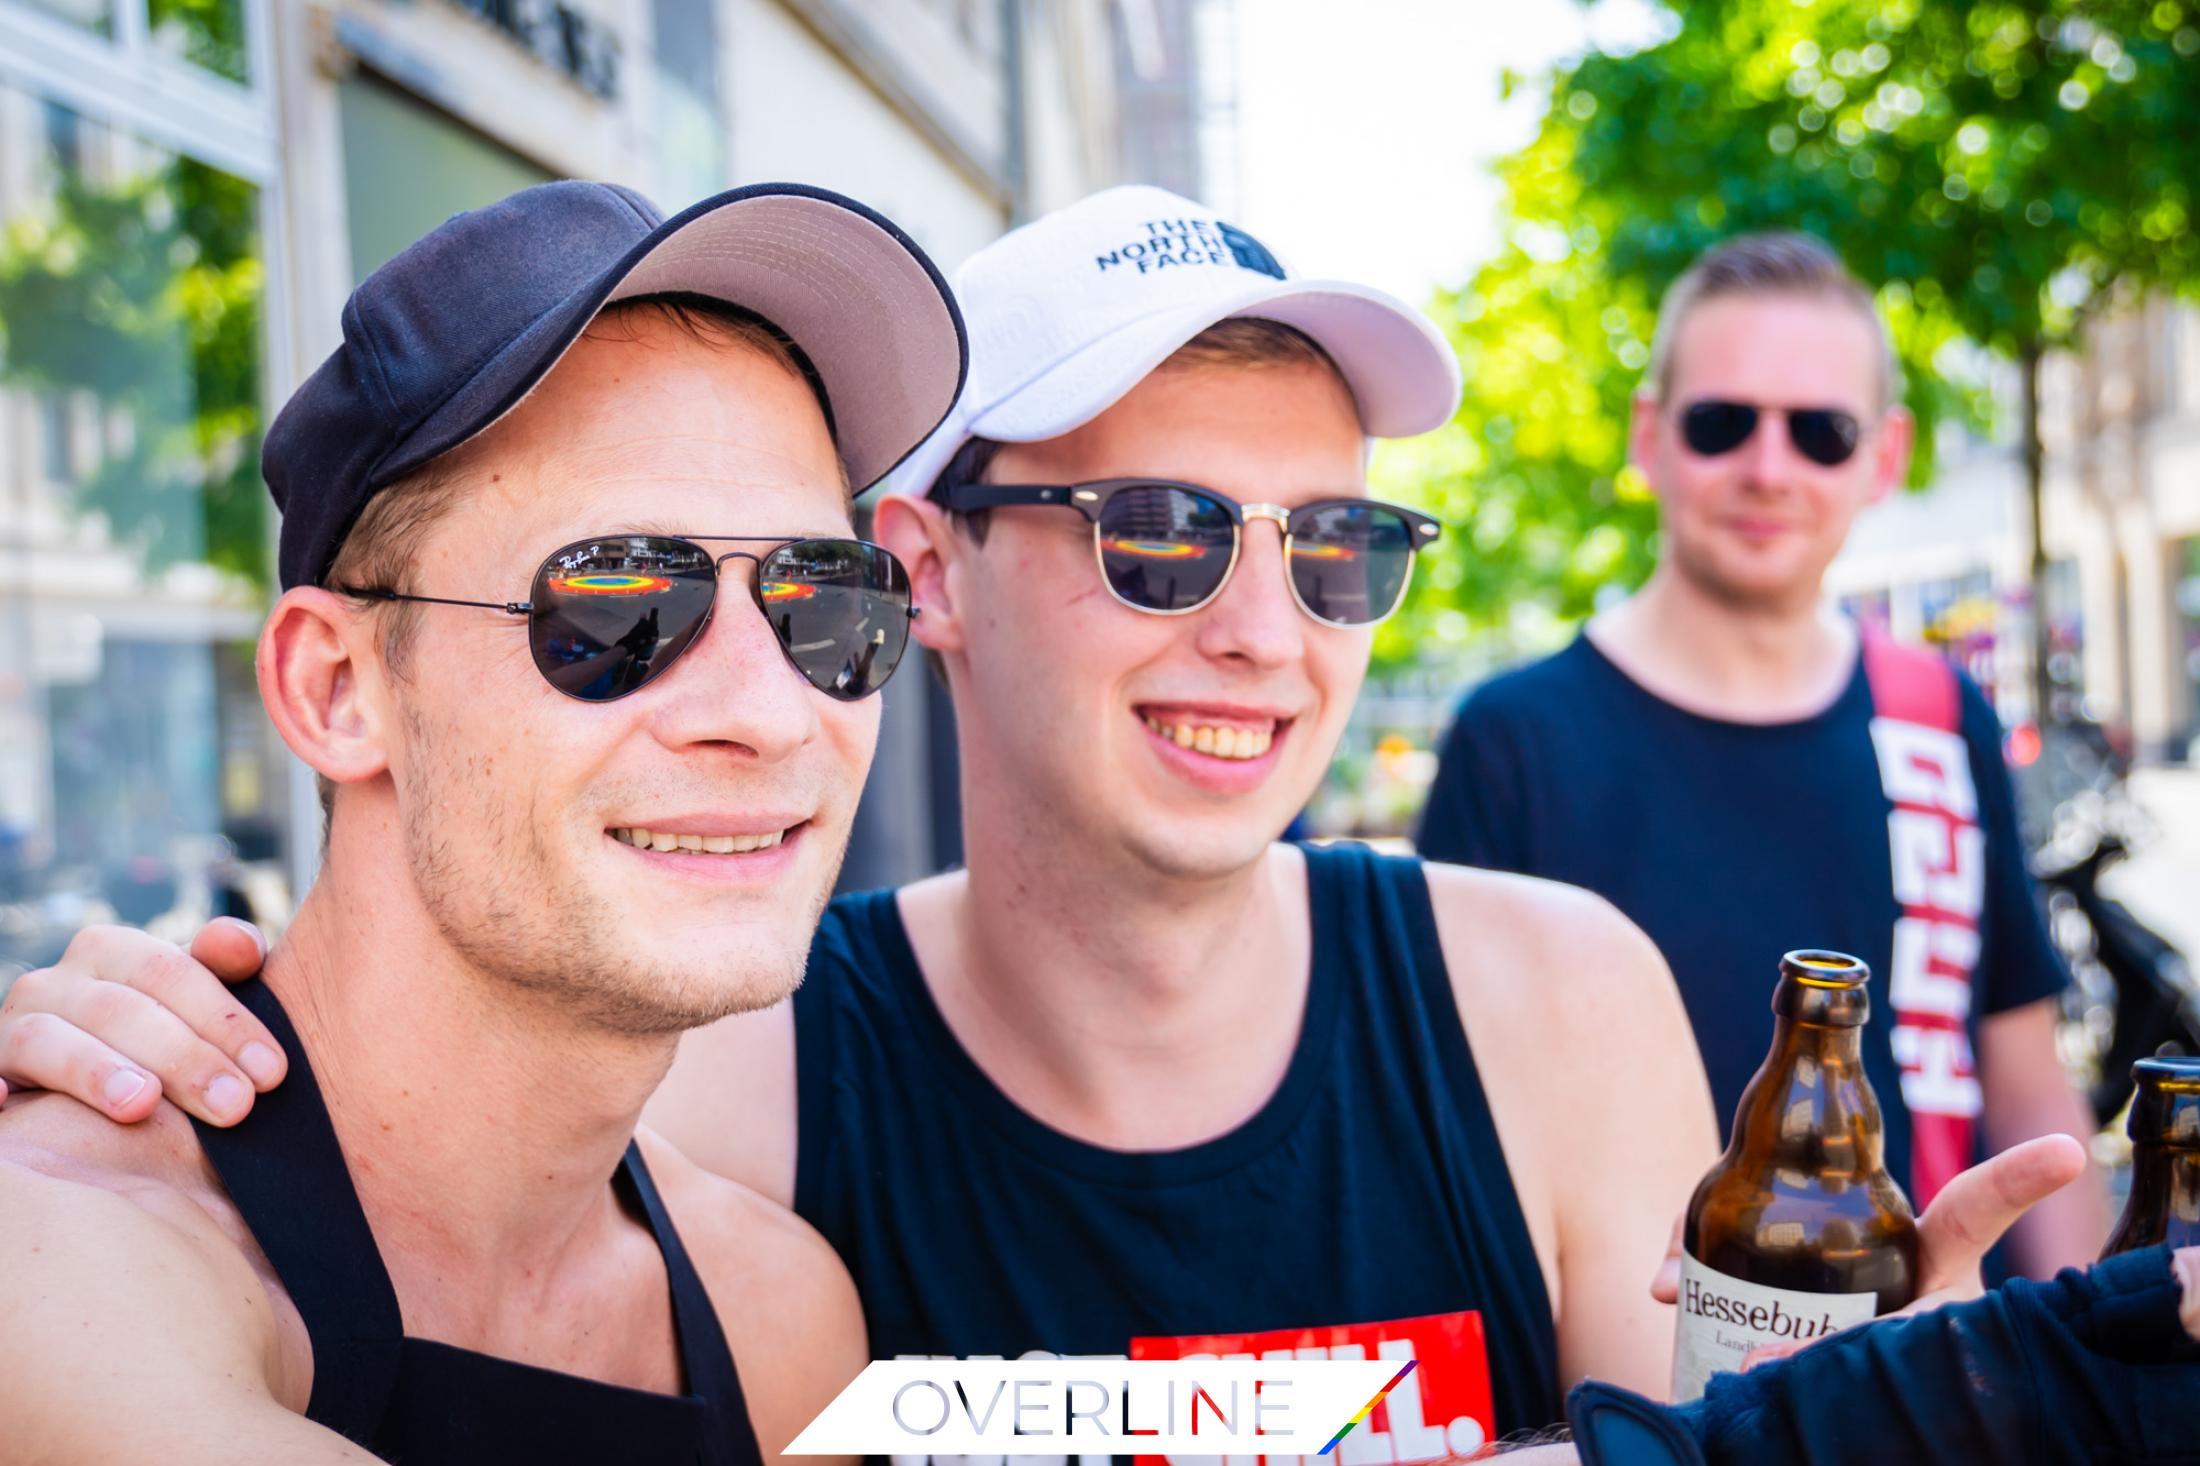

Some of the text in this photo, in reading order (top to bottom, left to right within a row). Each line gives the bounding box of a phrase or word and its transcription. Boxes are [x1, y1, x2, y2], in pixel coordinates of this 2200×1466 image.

[1140, 219, 1207, 235] THE
[1096, 234, 1223, 271] NORTH
[1136, 250, 1231, 274] FACE
